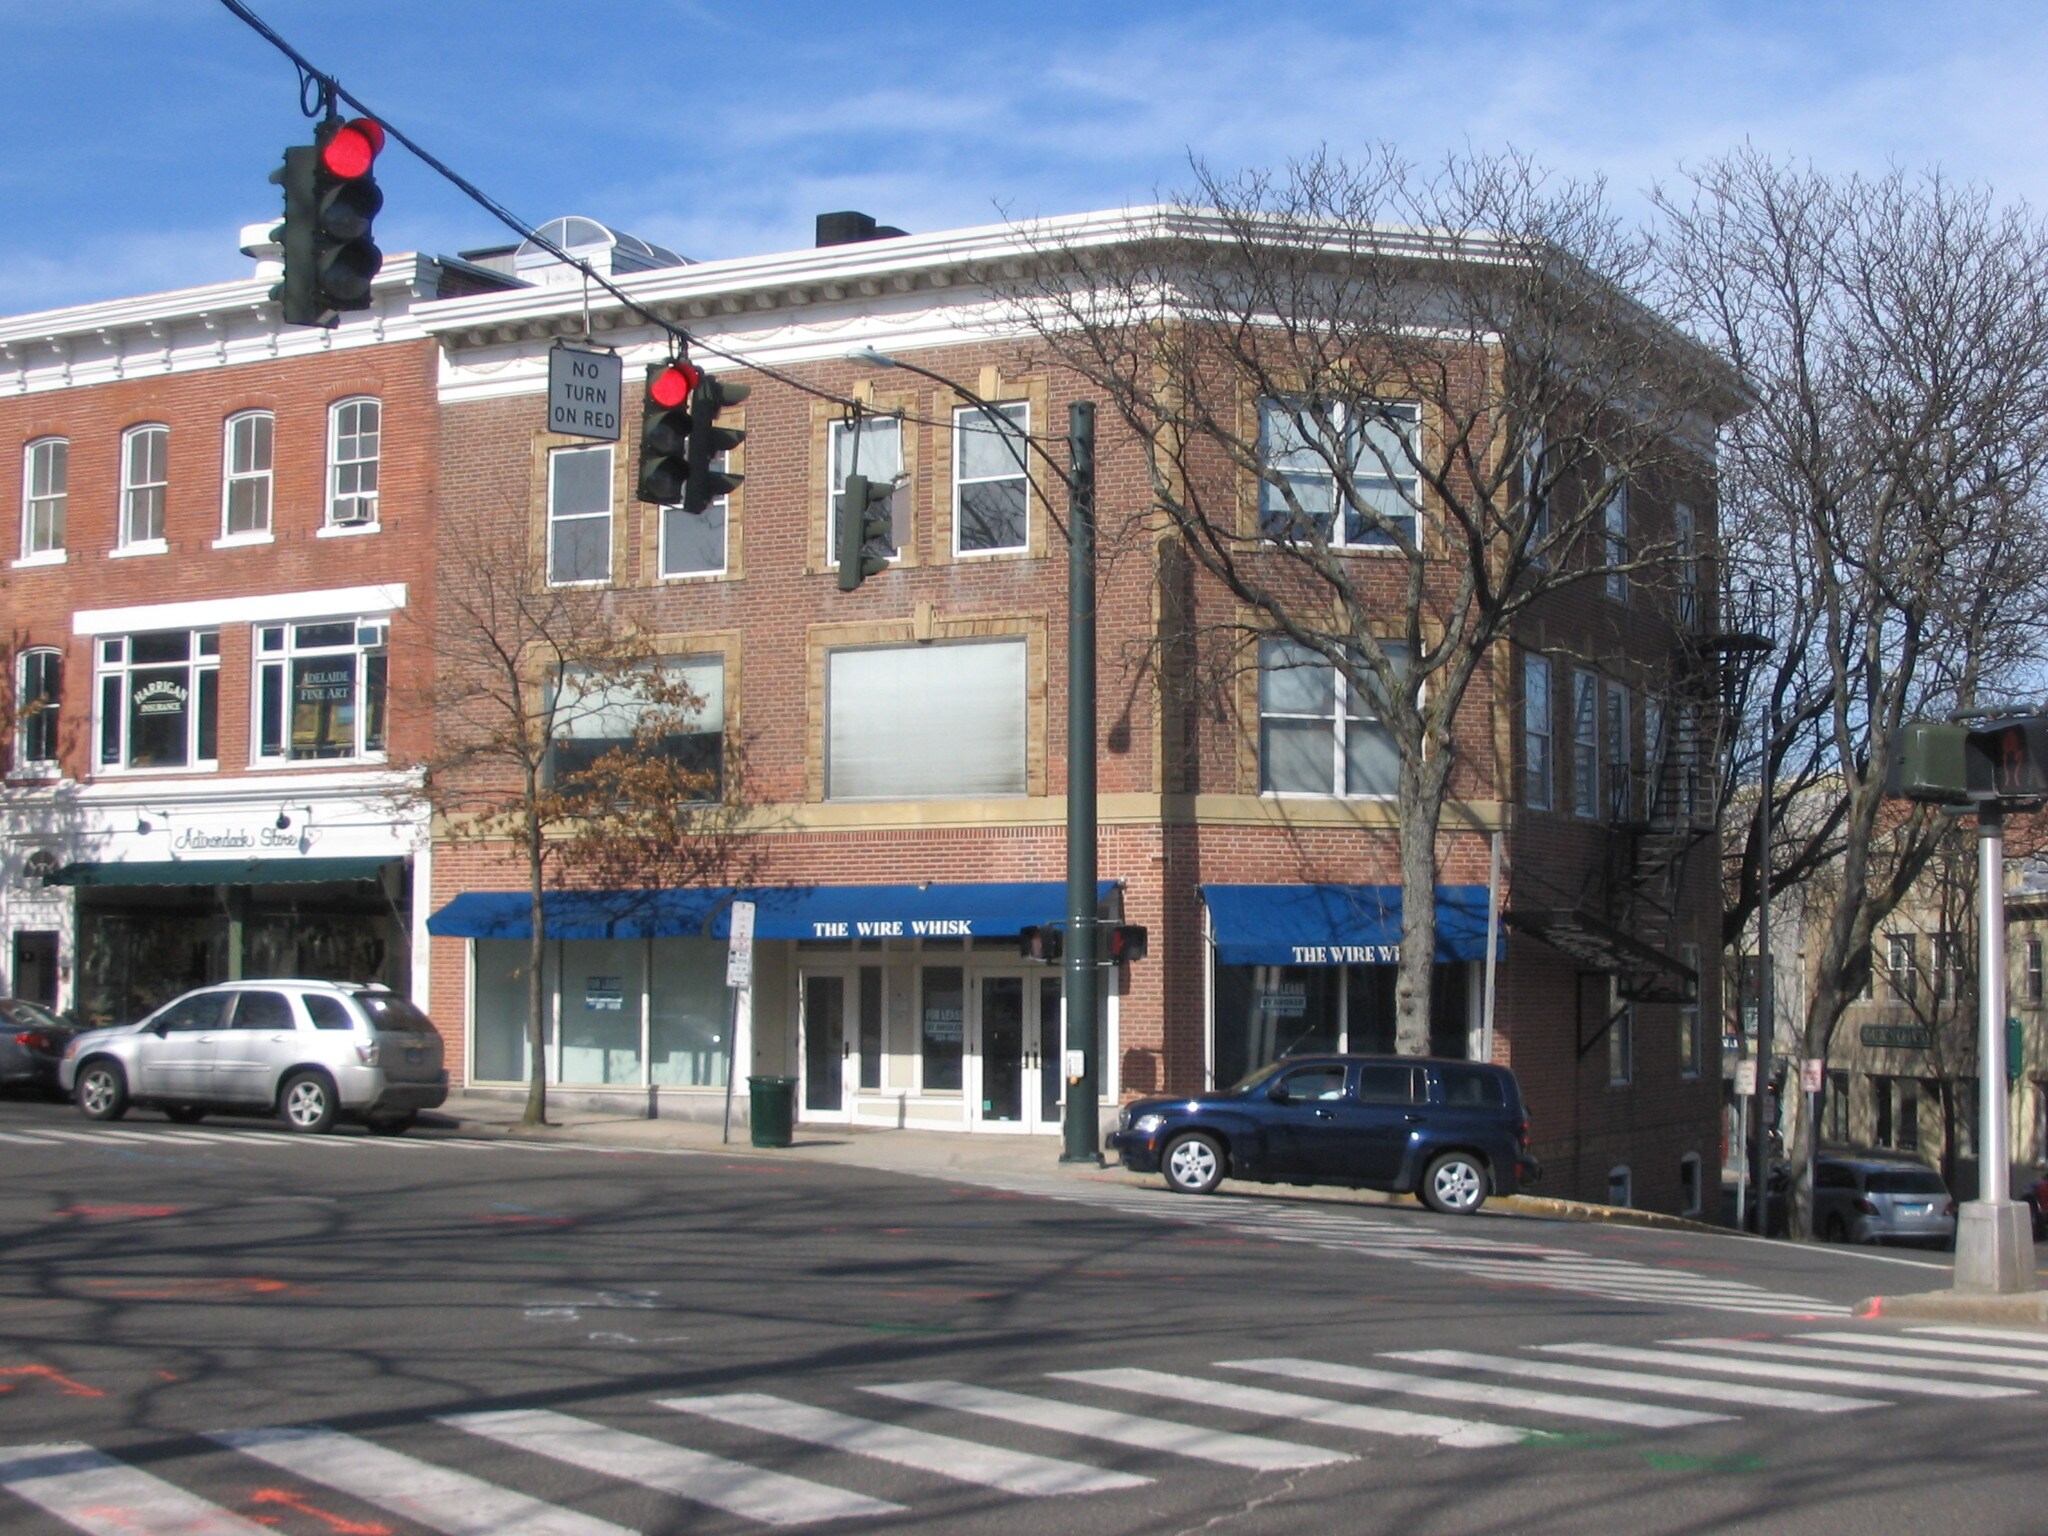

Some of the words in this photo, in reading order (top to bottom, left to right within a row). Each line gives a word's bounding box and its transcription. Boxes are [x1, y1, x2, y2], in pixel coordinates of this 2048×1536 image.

[573, 361, 599, 379] NO
[564, 383, 606, 404] TURN
[555, 406, 577, 424] ON
[584, 410, 615, 429] RED
[302, 671, 349, 684] ADELAIDE
[134, 681, 188, 705] HARRIGAN
[301, 689, 325, 700] FINE
[327, 688, 349, 699] ART
[140, 702, 181, 712] INSURANCE
[261, 826, 298, 847] Store
[813, 922, 849, 937] THE
[856, 921, 903, 936] WIRE
[911, 920, 972, 935] WHISK
[1292, 946, 1327, 963] THE
[1329, 946, 1375, 962] WIRE
